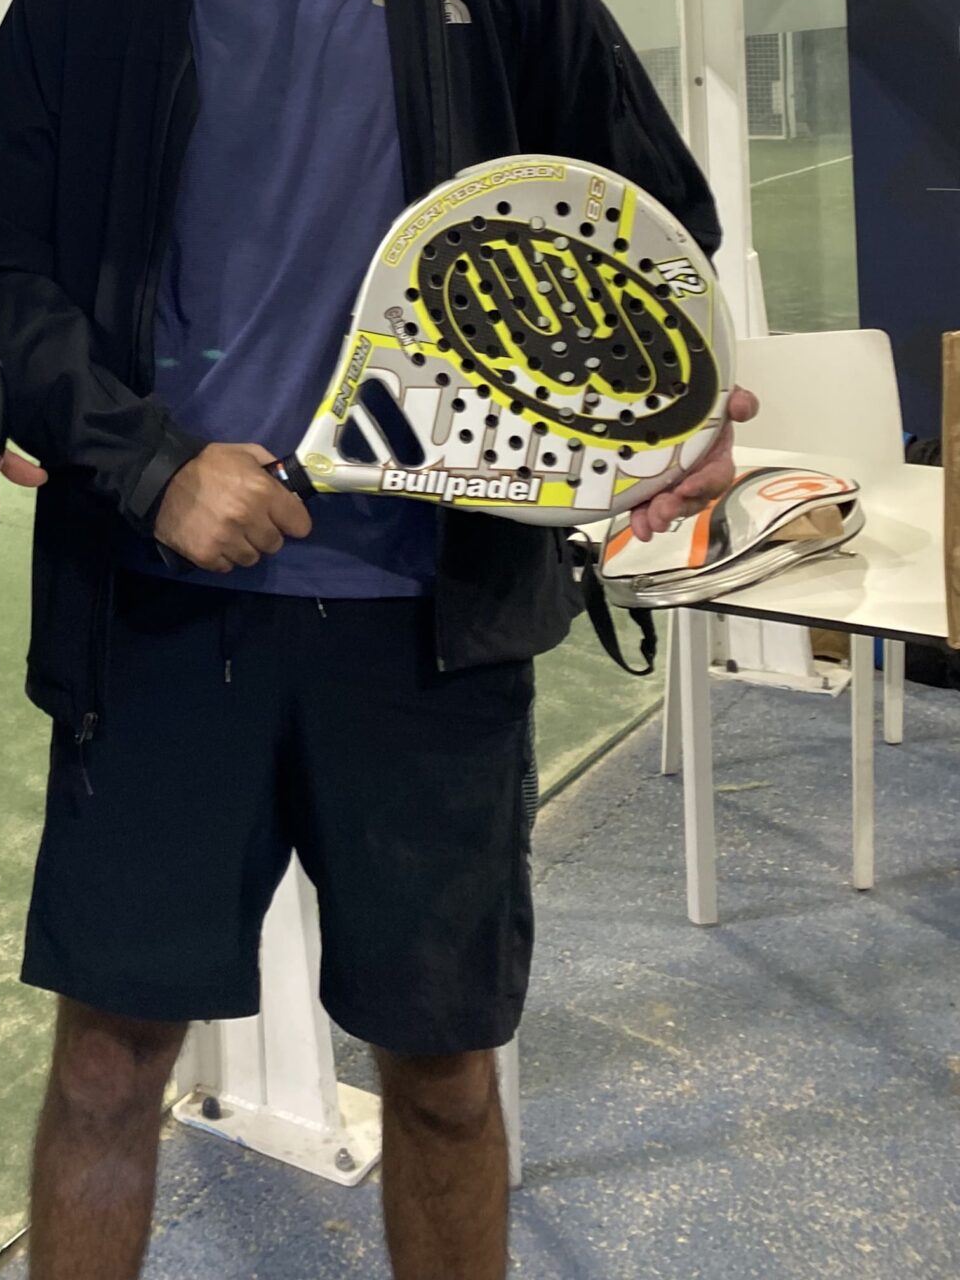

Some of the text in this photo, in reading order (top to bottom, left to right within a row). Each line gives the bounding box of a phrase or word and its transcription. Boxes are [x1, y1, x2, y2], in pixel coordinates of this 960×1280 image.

[491, 165, 564, 185] CARBON
[654, 257, 708, 299] K2
[381, 470, 542, 502] Bullpadel
